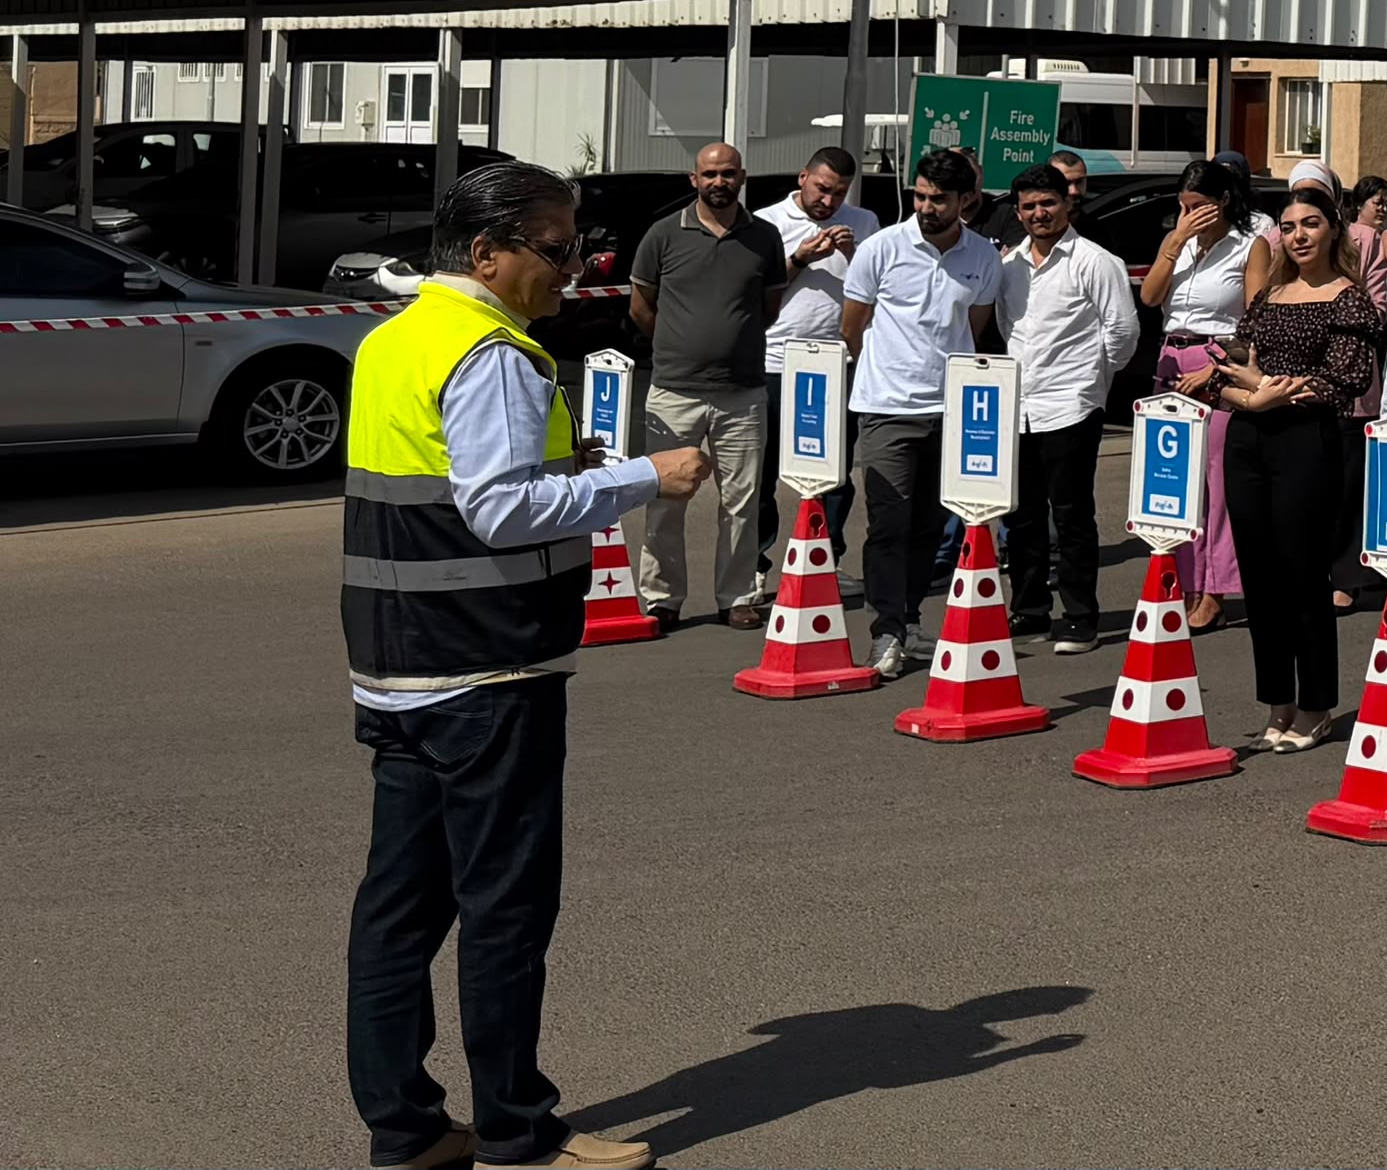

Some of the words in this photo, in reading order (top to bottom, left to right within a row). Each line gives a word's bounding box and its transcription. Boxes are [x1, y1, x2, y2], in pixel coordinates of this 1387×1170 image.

[1010, 110, 1034, 125] Fire
[990, 126, 1050, 146] Assembly
[1003, 147, 1034, 163] Point
[600, 376, 611, 402] J
[807, 377, 813, 406] I
[972, 390, 988, 421] H
[1157, 425, 1178, 459] G
